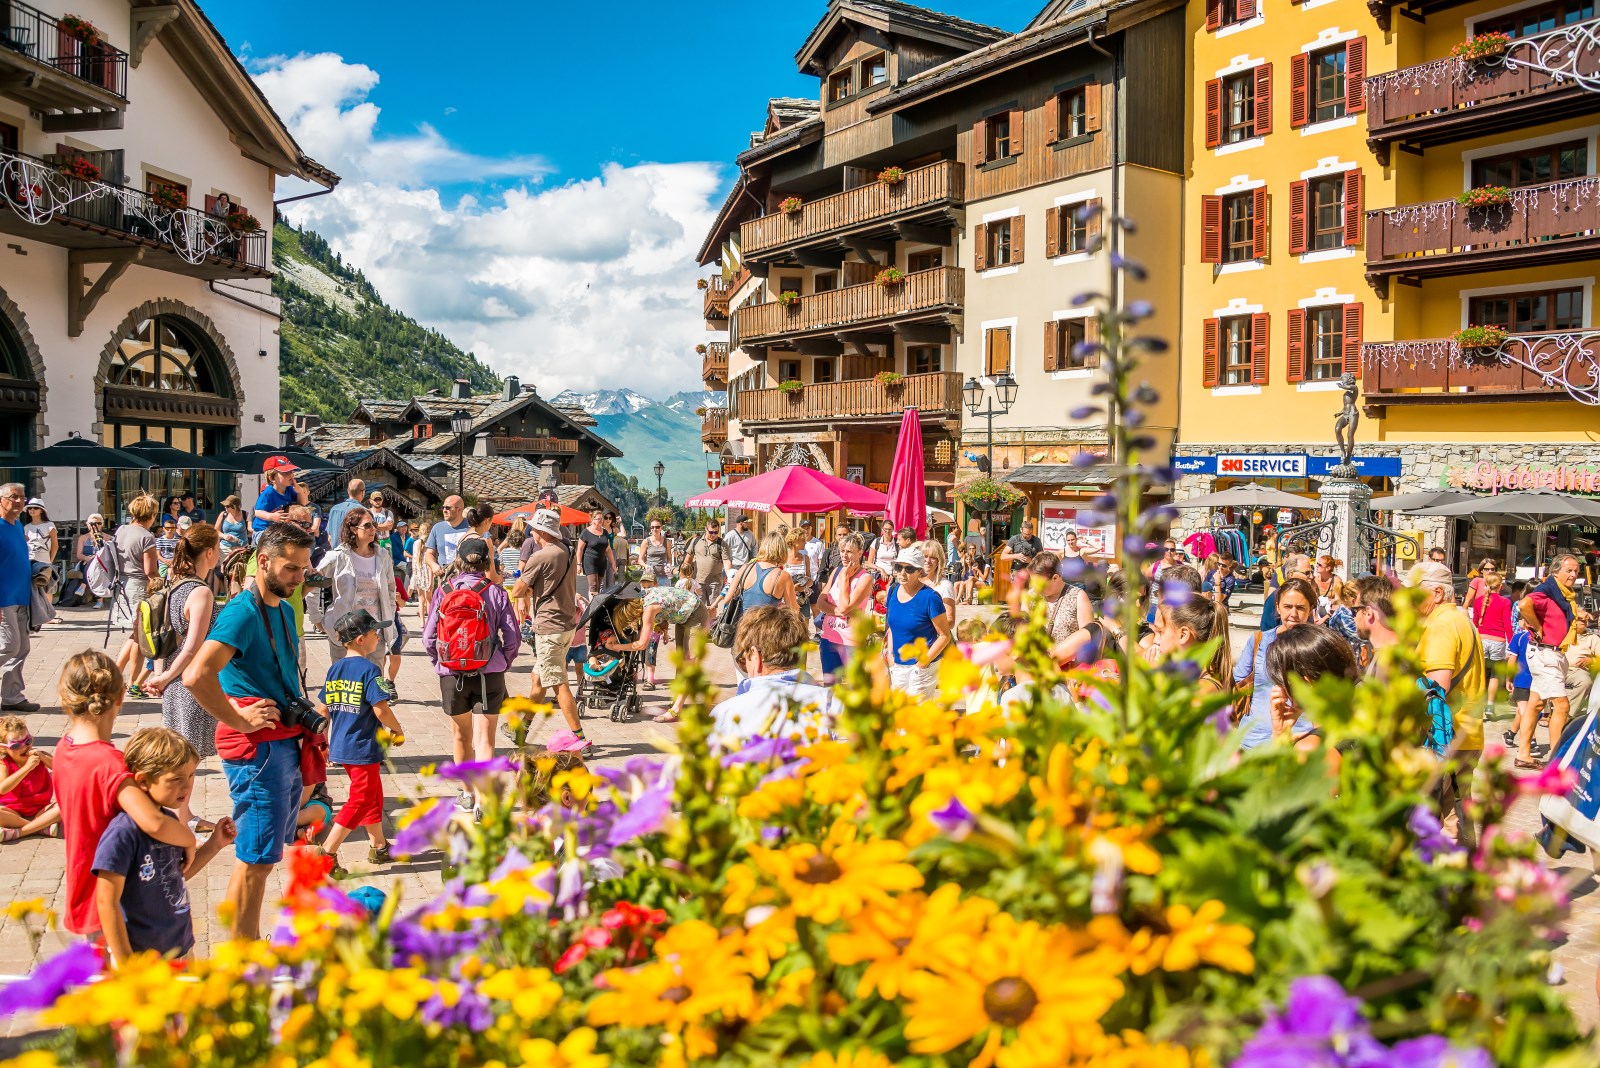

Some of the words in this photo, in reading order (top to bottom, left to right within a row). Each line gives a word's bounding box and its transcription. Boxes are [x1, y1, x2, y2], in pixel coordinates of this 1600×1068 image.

[723, 464, 750, 474] SPIRIT
[325, 679, 363, 694] RESCUE
[325, 692, 361, 705] FIRE
